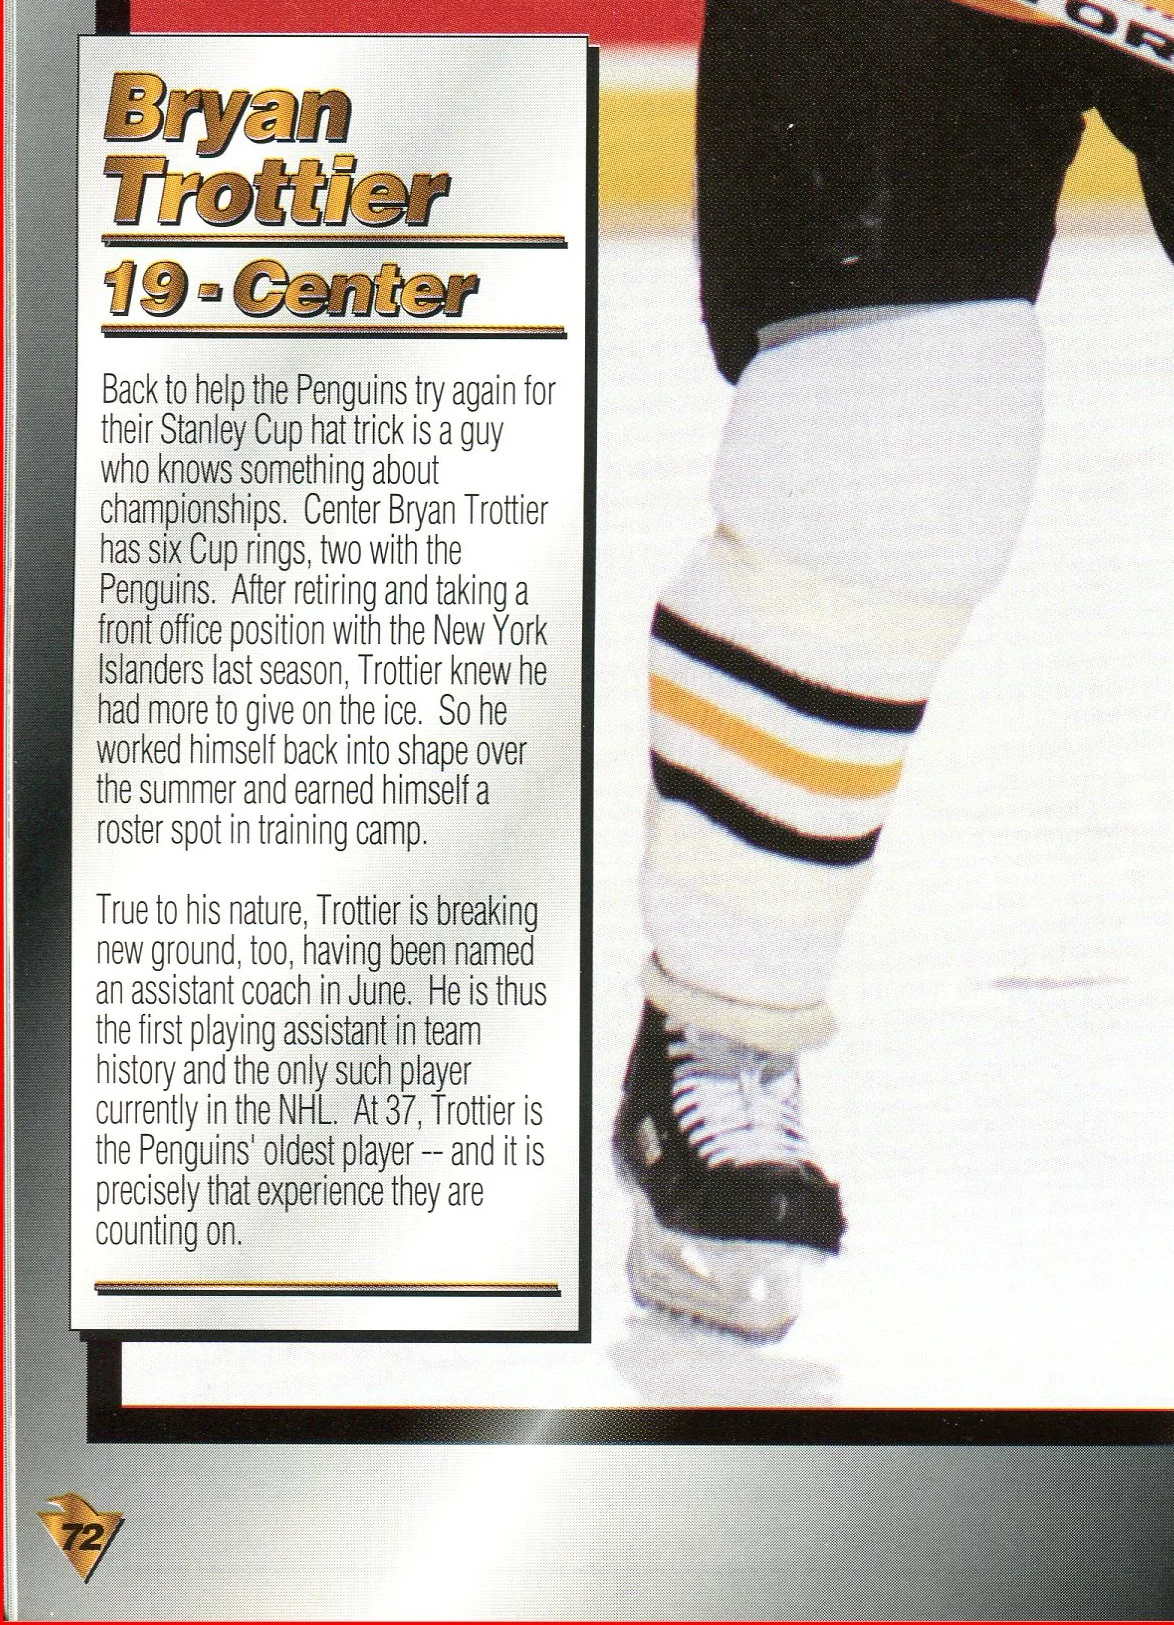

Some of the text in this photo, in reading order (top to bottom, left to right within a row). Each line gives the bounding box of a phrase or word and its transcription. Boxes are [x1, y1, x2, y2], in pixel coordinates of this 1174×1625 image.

[102, 70, 353, 158] Bryan
[102, 152, 453, 228] Trottier
[103, 258, 190, 319] 19
[231, 258, 481, 319] Center
[102, 372, 557, 413] Back to help the Penguins try again for
[101, 411, 504, 453] their Stanley Cup hat trick is a guy
[100, 452, 439, 492] who knows something about
[100, 491, 549, 532] championships. Center Bryan Trottier
[100, 531, 462, 572] has six Cup rings, two with the
[100, 572, 529, 613] Penguins. After retiring and taking a
[98, 612, 548, 652] front office position with the New York
[99, 653, 548, 691] Islanders last season, Trottier knew he
[98, 692, 508, 732] had more to give on the ice. So he
[96, 733, 528, 772] worked himself back into shape over
[96, 772, 490, 806] the summer and earned himself a
[97, 813, 427, 853] roster spot in training camp.
[96, 892, 538, 934] True to his nature, Trottier is breaking
[97, 934, 535, 973] new ground, too, having been named
[95, 973, 548, 1007] an assistant coach in June. He is thus
[95, 1013, 481, 1053] the first playing assistant in team
[96, 1053, 472, 1093] history and the only such player
[95, 1093, 544, 1132] currently in the NHL. At 37, Trottier is
[95, 1133, 131, 1166] the
[139, 1132, 255, 1173] Penguins'
[264, 1134, 335, 1166] oldest
[342, 1134, 415, 1173] player
[450, 1134, 495, 1167] and
[504, 1134, 517, 1166] it
[526, 1134, 545, 1167] is
[96, 1173, 484, 1214] precisely that experience they are
[95, 1214, 242, 1253] counting on.
[61, 1523, 105, 1551] 72
